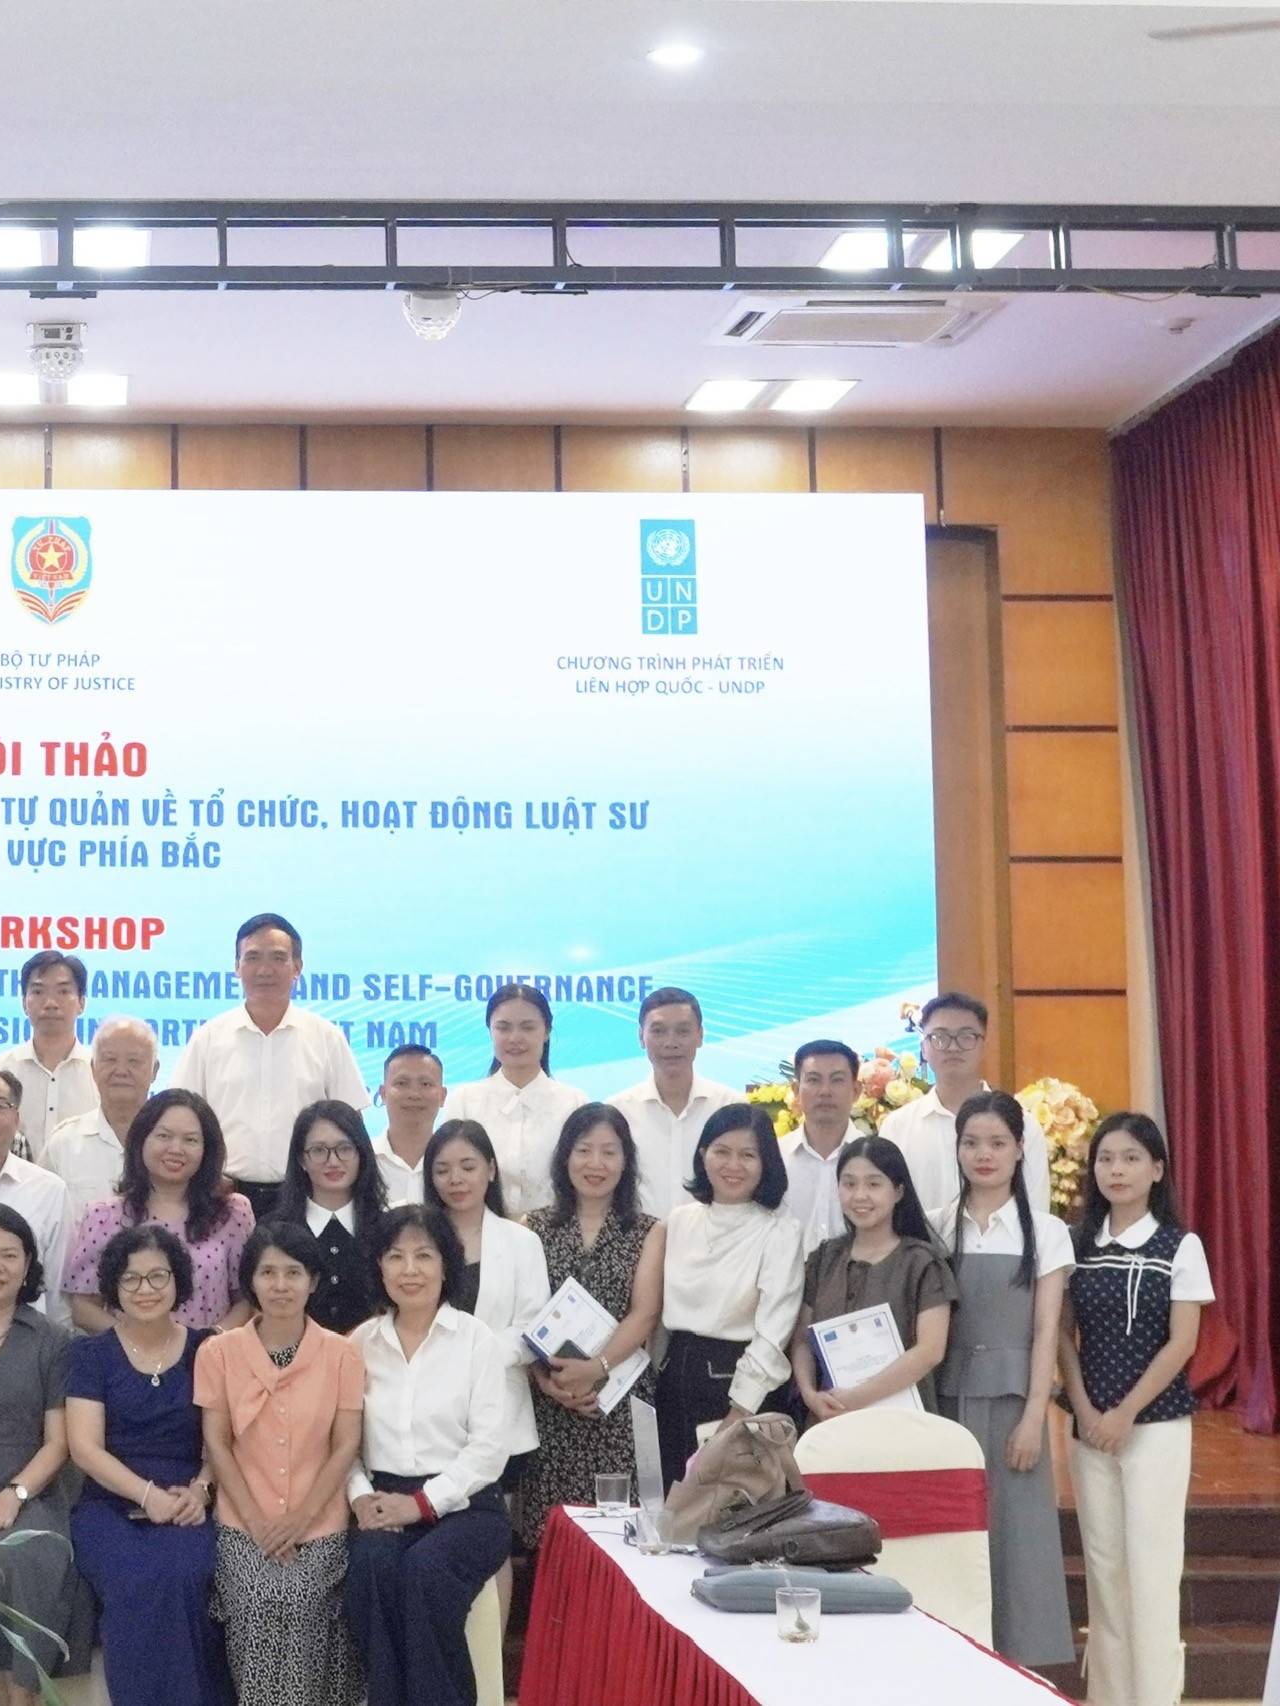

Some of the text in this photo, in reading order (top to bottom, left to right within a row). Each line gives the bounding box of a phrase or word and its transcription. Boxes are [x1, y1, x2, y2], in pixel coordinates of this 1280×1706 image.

[0, 650, 100, 670] BỘ TƯ PHÁP
[556, 651, 784, 670] CHƯƠNG TRÌNH PHÁT TRIỂN
[48, 677, 69, 690] OF
[73, 677, 136, 691] JUSTICE
[575, 677, 609, 693] LIÊN
[615, 680, 650, 696] HỢP
[655, 676, 703, 695] QUỐC
[719, 681, 766, 694] UNDP
[40, 732, 148, 777] THẢO
[0, 796, 39, 831] TỰ
[49, 790, 129, 827] QUẢN
[142, 788, 177, 827] VỀ
[189, 788, 224, 828] TỔ
[237, 794, 328, 831] CHỨC,
[341, 800, 417, 835] HOẠT
[428, 796, 512, 836] ĐỘNG
[526, 796, 597, 837] LUẬT
[609, 800, 650, 831] SƯ
[7, 838, 67, 875] VỰC
[80, 834, 149, 869] PHÍA
[161, 830, 221, 869] BẮC
[290, 973, 350, 1001] AND
[367, 1021, 437, 1048] NAM
